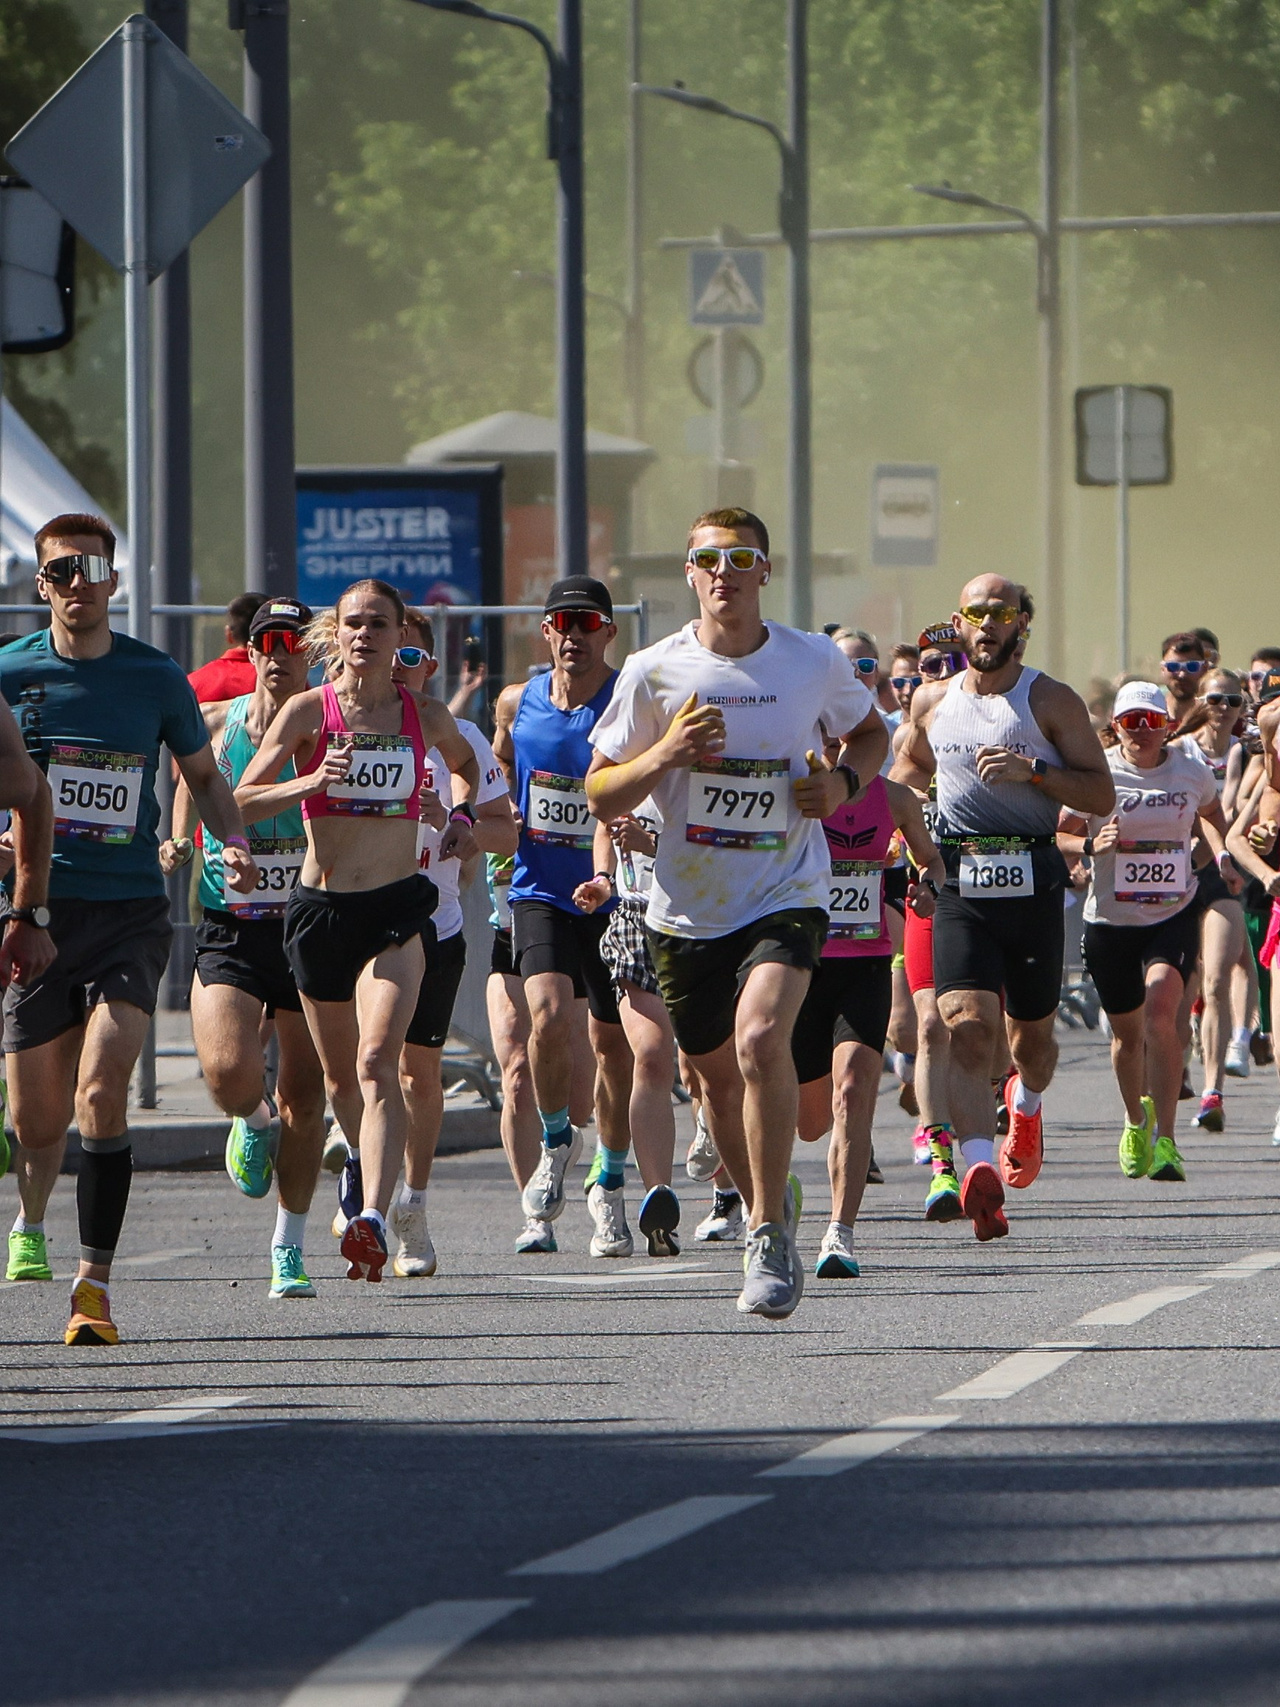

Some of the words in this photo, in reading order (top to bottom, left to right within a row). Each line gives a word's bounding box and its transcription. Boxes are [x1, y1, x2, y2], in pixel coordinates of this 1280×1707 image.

[304, 507, 450, 540] JUSTER
[926, 627, 955, 642] WTF
[759, 695, 777, 703] AIR
[343, 763, 404, 788] 4607
[59, 778, 128, 812] 5050
[704, 785, 775, 818] 7979
[538, 798, 590, 826] 3307
[255, 865, 302, 891] 837
[969, 865, 1024, 888] 1388
[1125, 863, 1176, 883] 3282
[829, 887, 870, 912] 226
